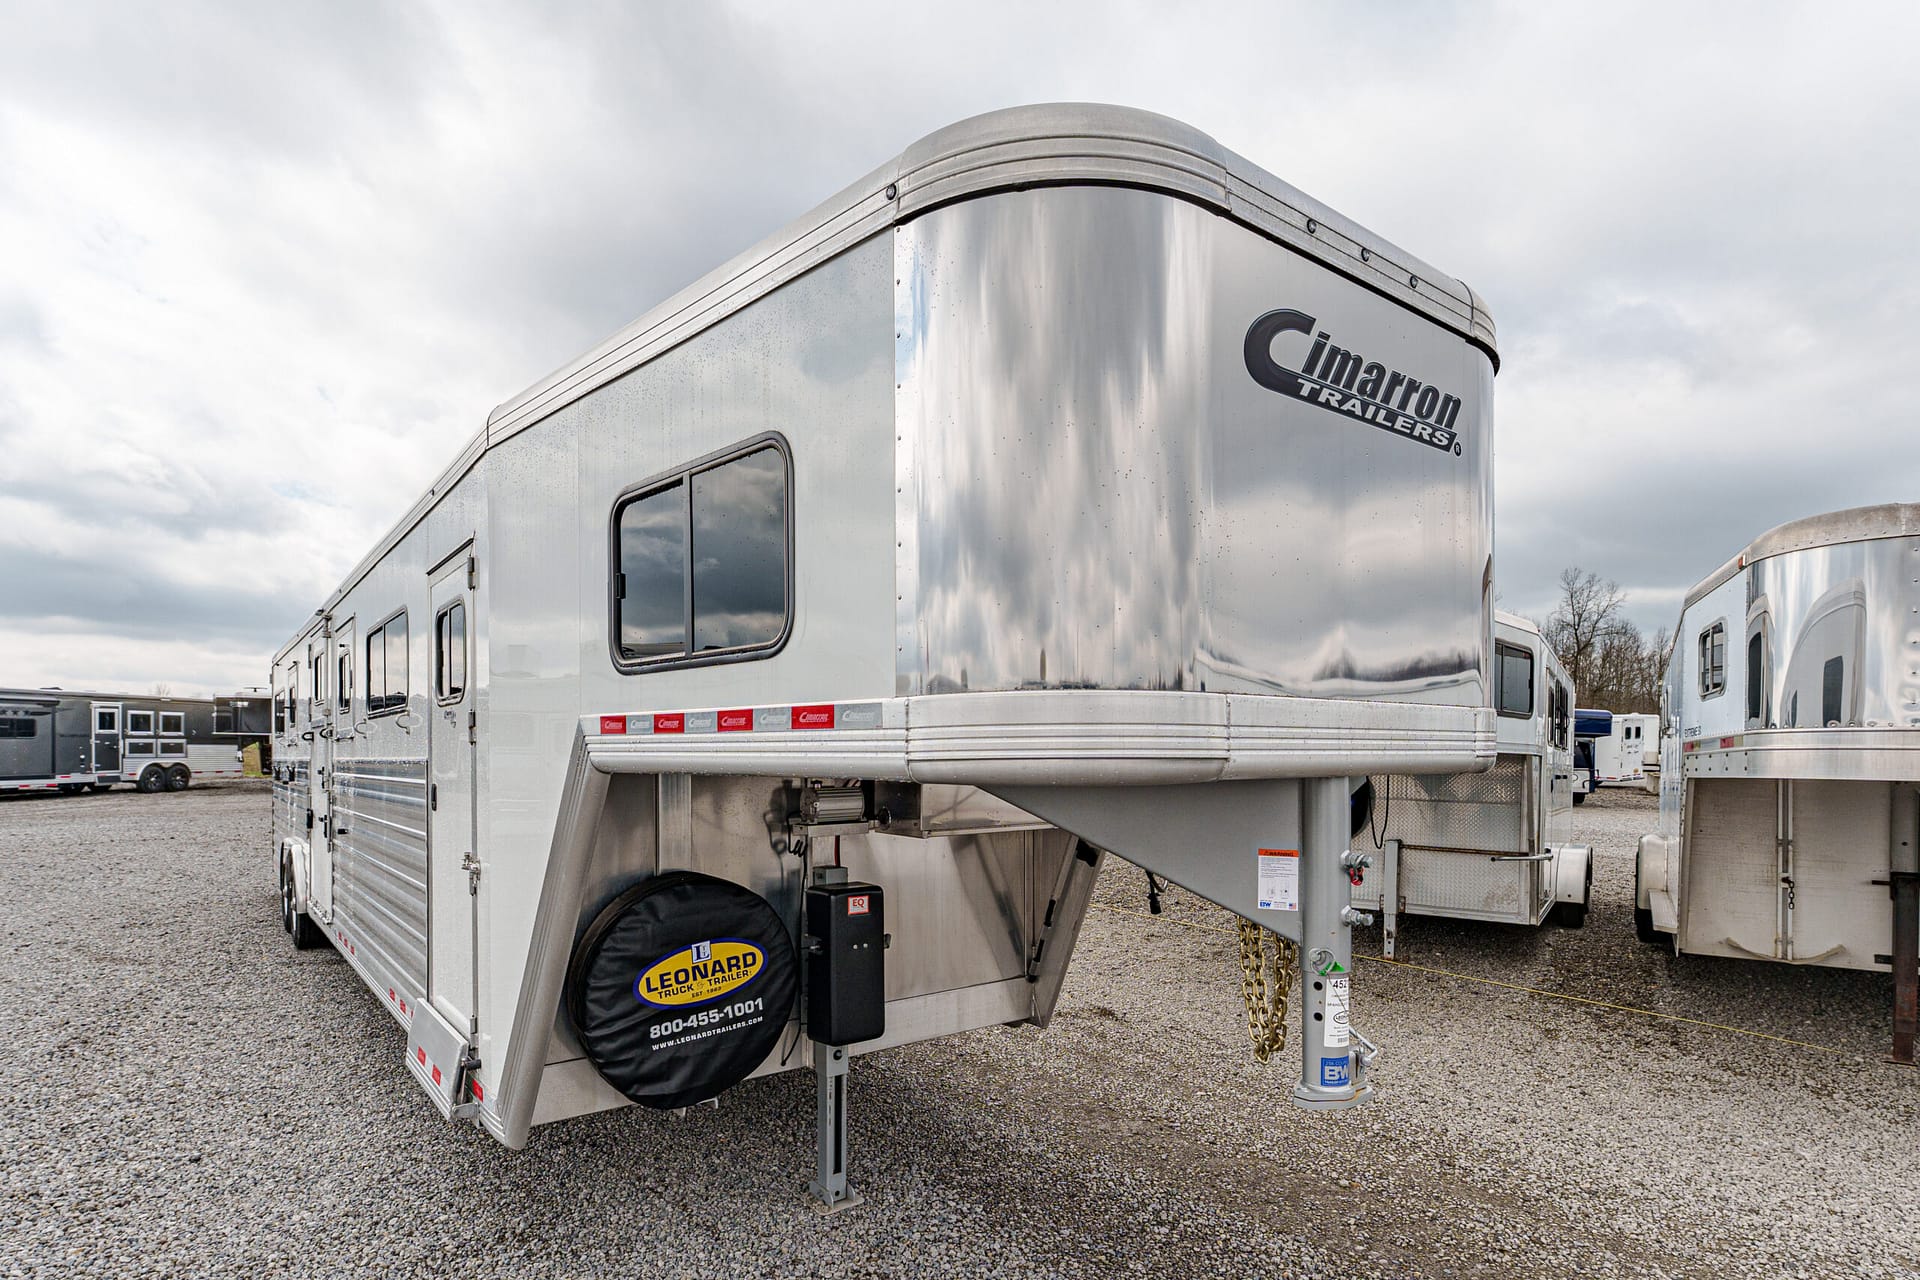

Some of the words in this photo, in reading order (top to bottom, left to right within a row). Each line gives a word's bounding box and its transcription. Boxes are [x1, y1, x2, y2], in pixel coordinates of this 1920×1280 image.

[1243, 308, 1462, 431] Cimarron
[1297, 378, 1451, 447] TRAILERS
[852, 898, 865, 908] EQ
[645, 951, 757, 994] LEONARD
[657, 983, 694, 1000] TRUCK
[707, 969, 749, 987] TRAILER
[649, 997, 764, 1039] 800-455-1001
[651, 1015, 764, 1051] WWW.LEONARDTRAILERS.COM
